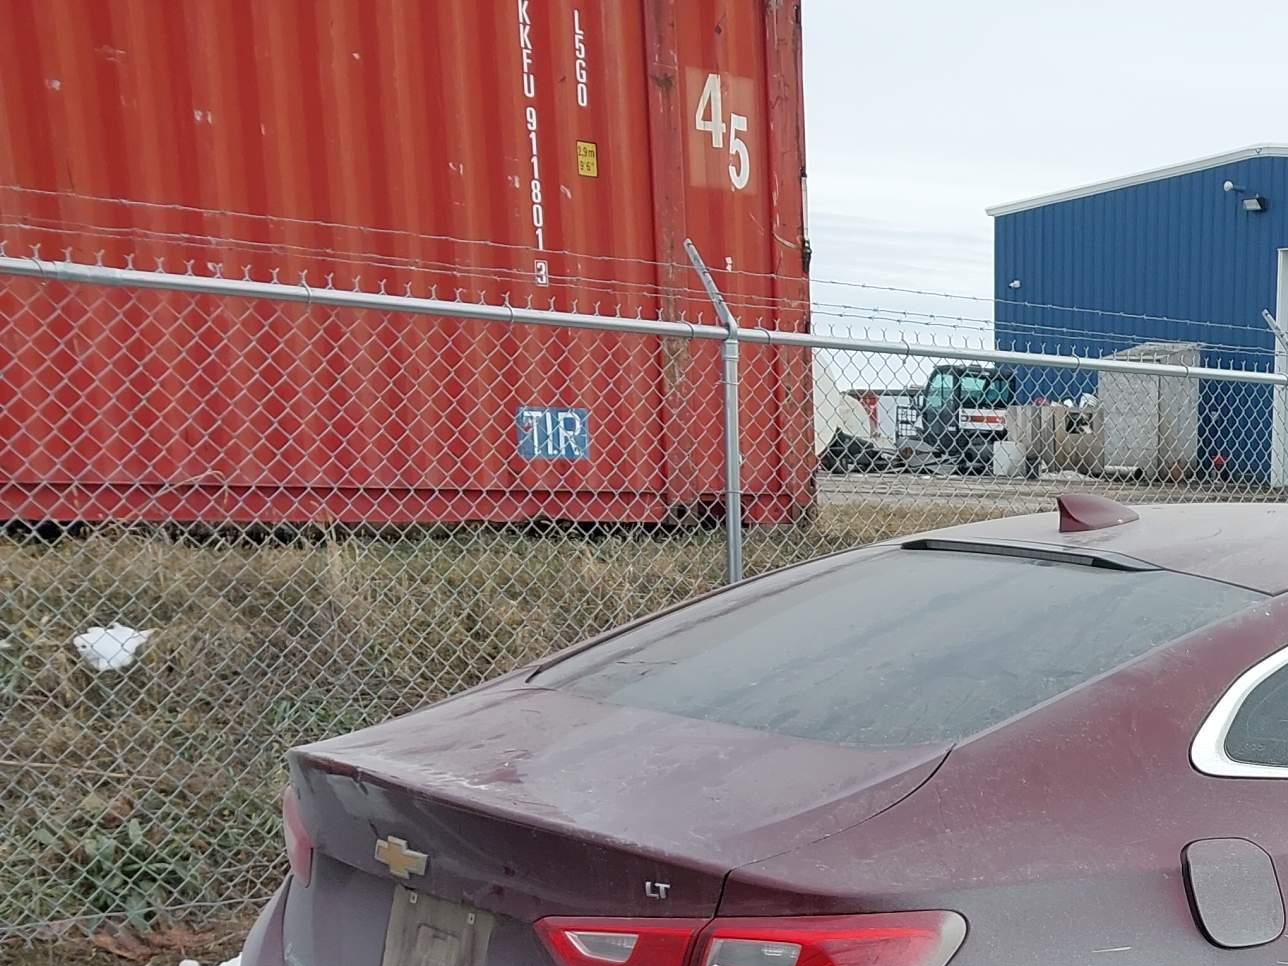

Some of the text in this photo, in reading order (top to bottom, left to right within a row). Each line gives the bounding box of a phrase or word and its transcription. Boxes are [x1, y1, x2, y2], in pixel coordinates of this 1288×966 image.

[517, 0, 535, 98] KKFU
[526, 107, 544, 250] 911801
[645, 881, 671, 900] LT
